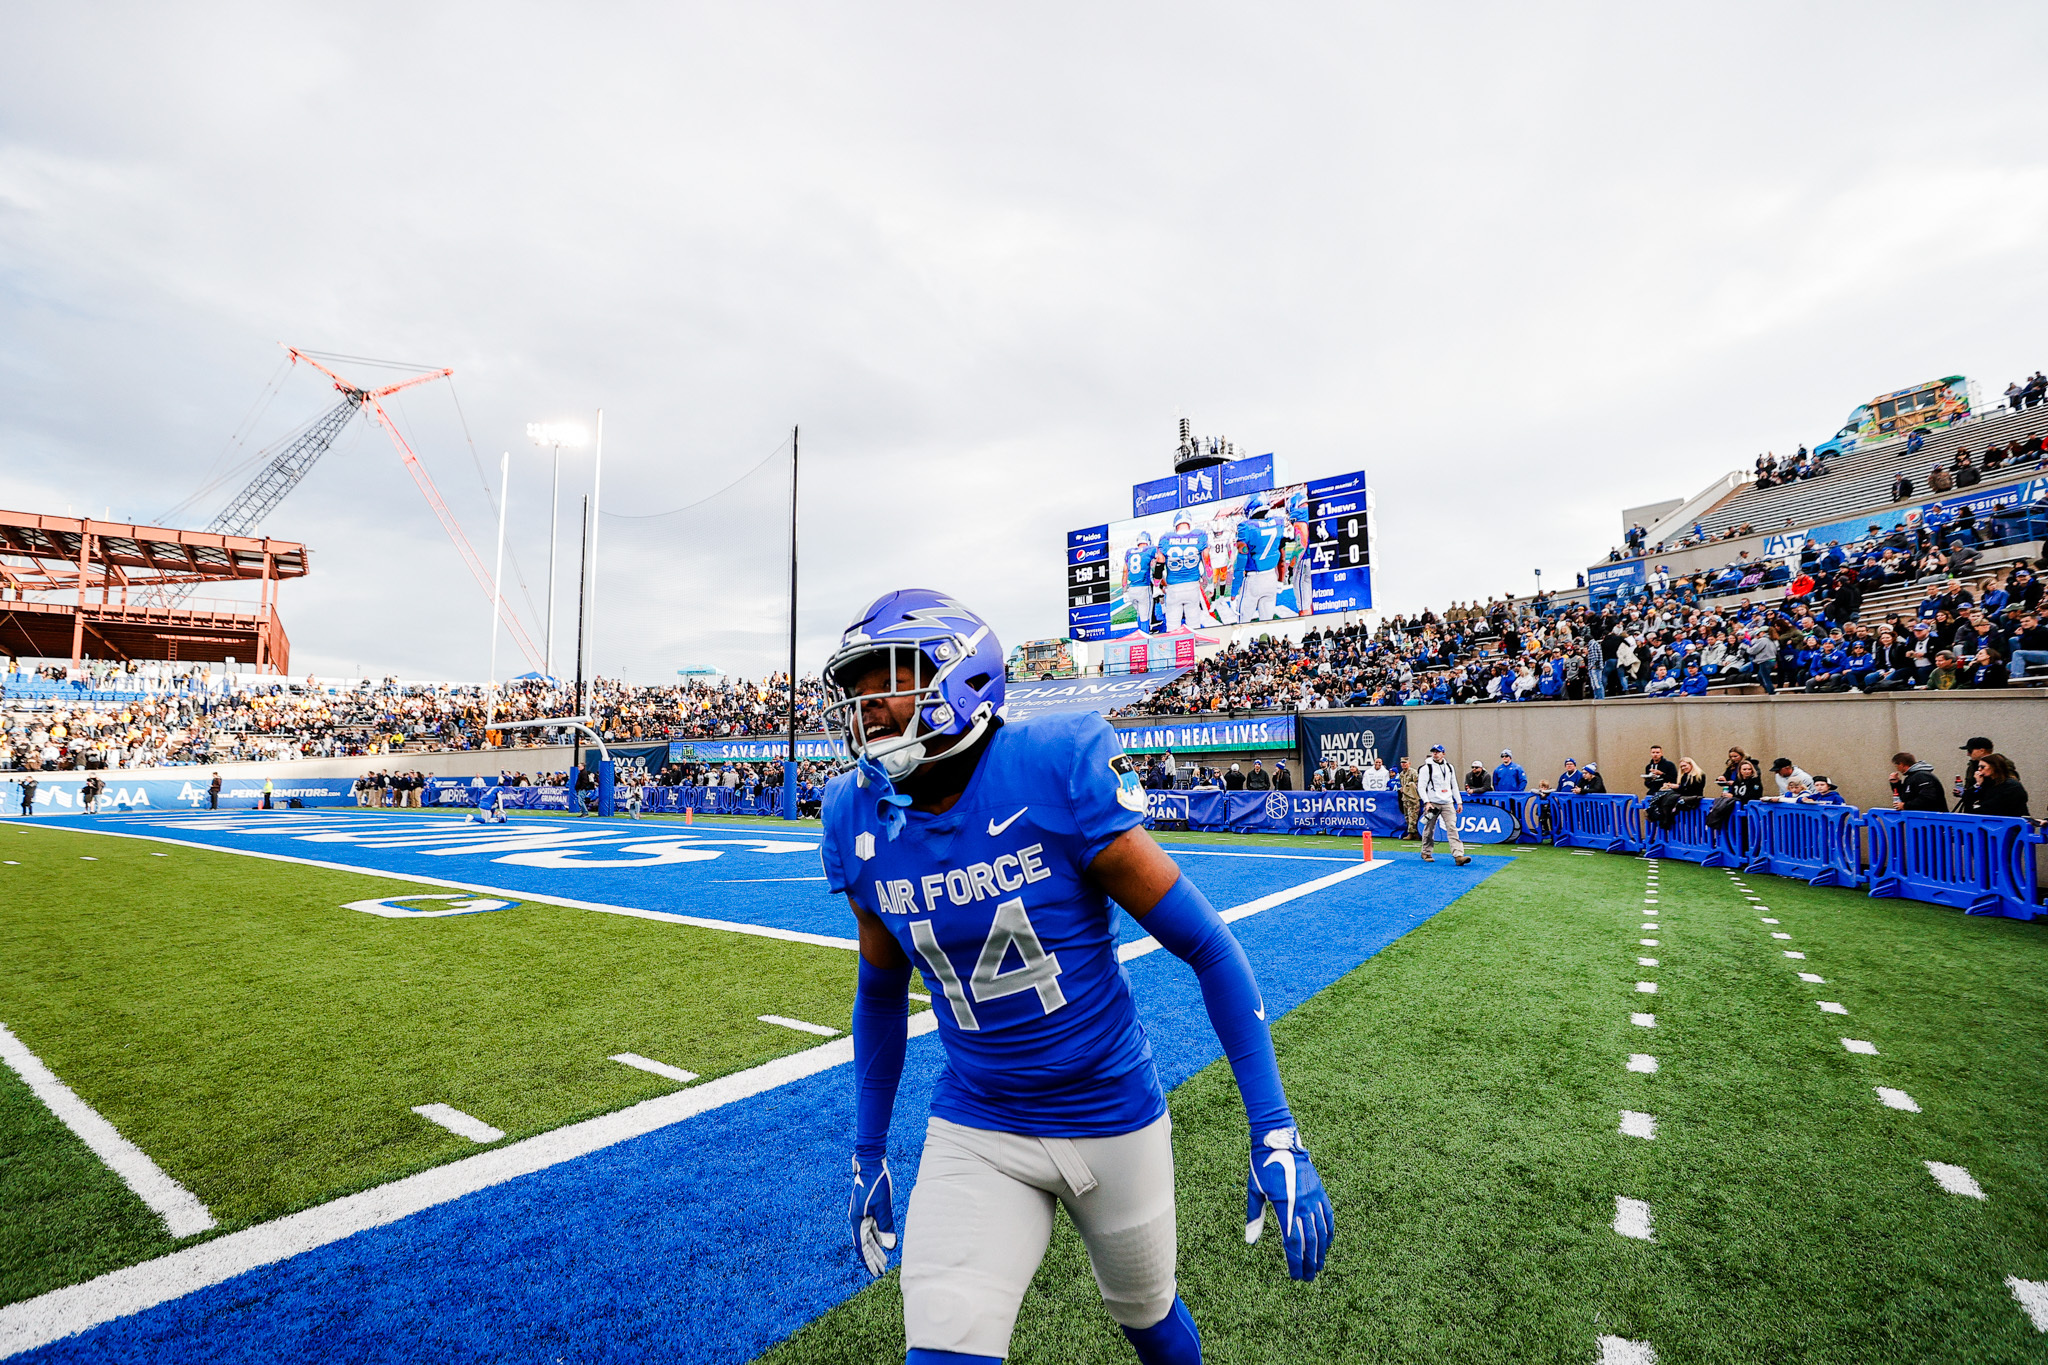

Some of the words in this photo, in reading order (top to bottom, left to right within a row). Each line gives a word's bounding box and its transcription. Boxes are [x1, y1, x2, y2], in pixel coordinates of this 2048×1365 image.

[1224, 470, 1267, 485] CommonSpirit
[1145, 490, 1178, 502] BOEING
[1187, 490, 1213, 504] USAA
[1348, 519, 1358, 538] 0
[1083, 533, 1102, 542] leidos
[1259, 527, 1278, 560] 7
[1313, 546, 1335, 568] AF
[1349, 544, 1360, 564] 0
[1130, 554, 1143, 575] 8
[1312, 588, 1334, 599] Arizona
[1312, 600, 1349, 611] Washington
[1349, 598, 1356, 607] St
[1005, 676, 1166, 701] CHANGE
[1144, 729, 1175, 748] AND
[1182, 727, 1219, 746] HEAL
[1226, 722, 1269, 744] LIVES
[1320, 732, 1361, 750] NAVY
[722, 745, 756, 758] SAVE
[762, 744, 790, 758] AND
[797, 743, 829, 757] HEAL
[613, 757, 634, 767] AVY
[1370, 779, 1383, 789] 25
[177, 781, 206, 807] AF
[668, 788, 678, 805] AF
[706, 788, 716, 805] AF
[1293, 797, 1377, 813] L3HARRIS
[1294, 816, 1318, 826] FAST.
[1320, 816, 1368, 826] FORWARD.
[875, 878, 920, 915] AIR
[920, 843, 1052, 911] FORCE
[909, 896, 1068, 1031] 14
